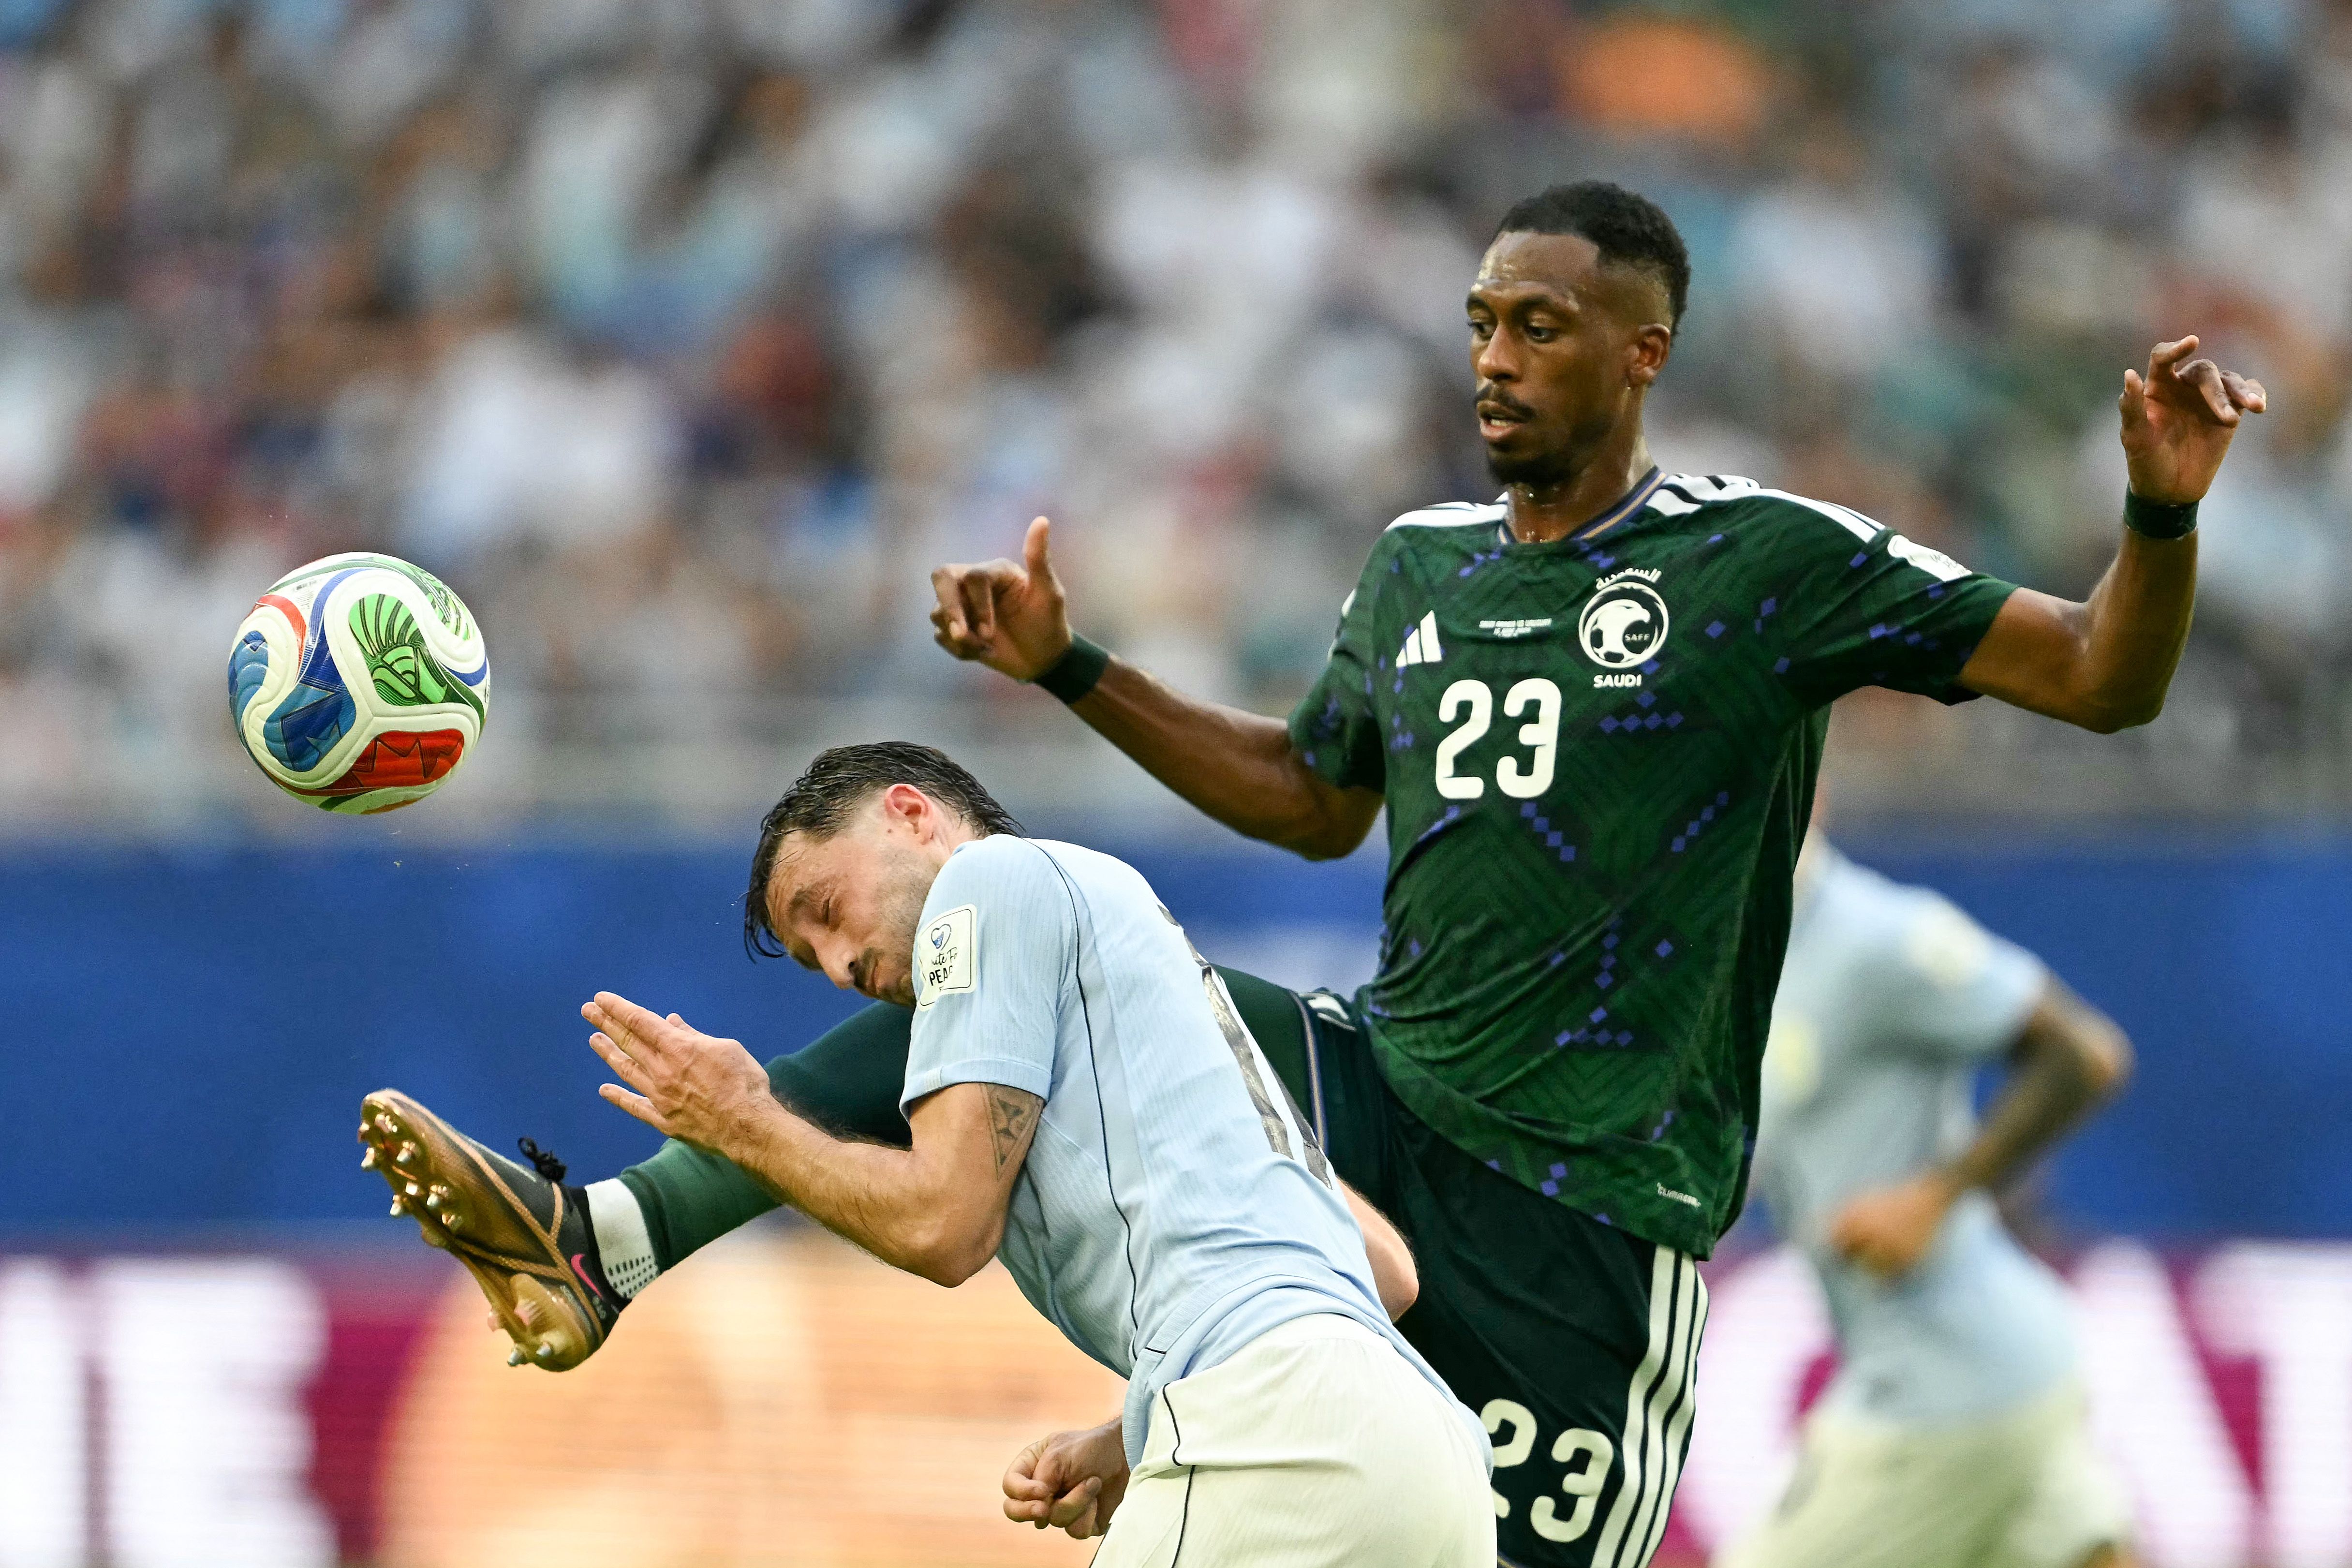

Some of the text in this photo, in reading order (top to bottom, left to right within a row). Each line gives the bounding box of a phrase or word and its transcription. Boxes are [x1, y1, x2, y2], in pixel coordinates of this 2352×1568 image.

[1596, 568, 1662, 591] السعودية
[1624, 633, 1651, 642] SAFF
[1593, 674, 1642, 688] SAUDI
[1435, 678, 1562, 799] 23
[1479, 1398, 1614, 1543] 23
